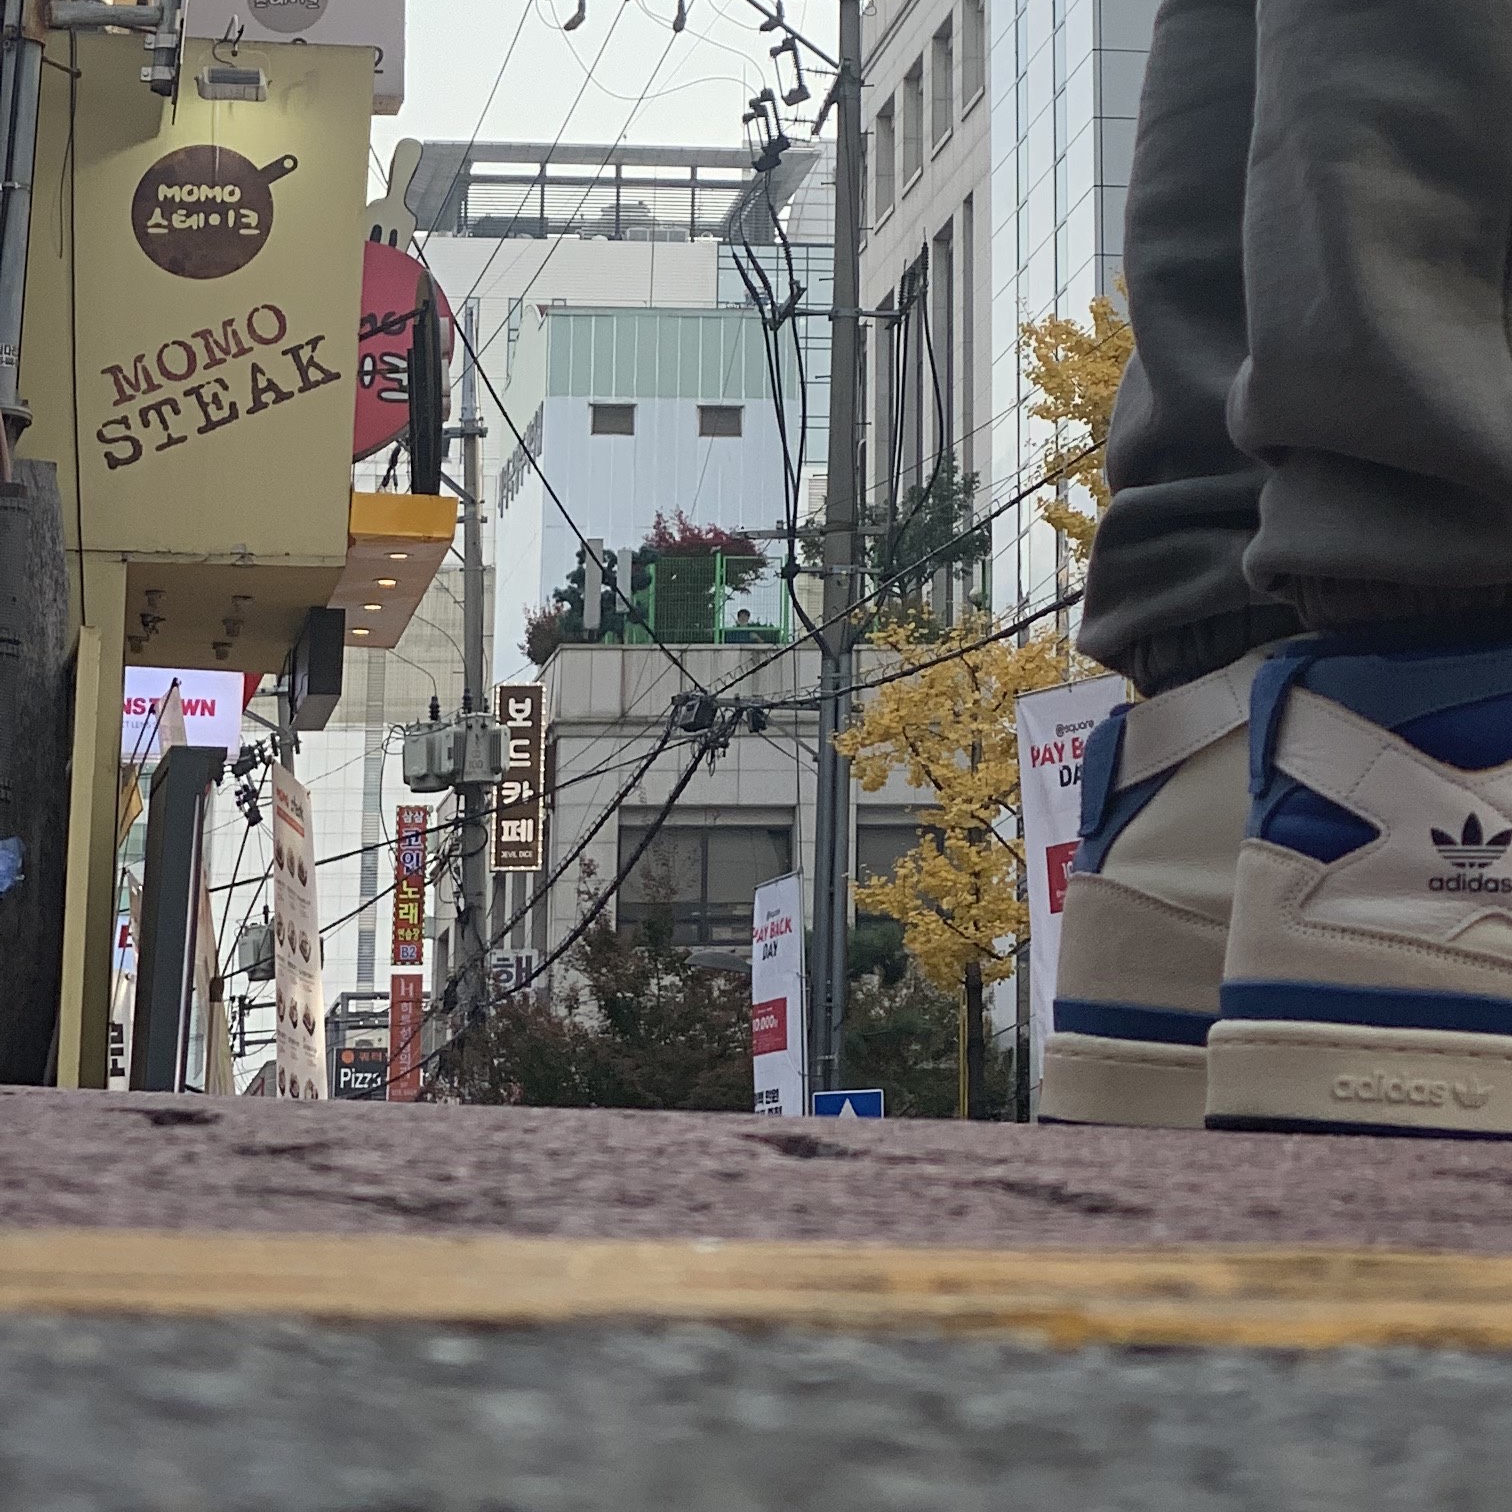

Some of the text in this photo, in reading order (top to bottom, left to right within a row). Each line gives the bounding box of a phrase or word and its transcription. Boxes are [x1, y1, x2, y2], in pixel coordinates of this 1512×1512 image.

[157, 183, 242, 205] MOMO
[146, 210, 261, 236] 스테이크
[100, 303, 288, 407] MOMO
[96, 335, 342, 470] STEAK
[1030, 738, 1066, 768] PAY
[501, 697, 535, 843] 보드카페
[1428, 871, 1512, 895] adidas
[398, 879, 421, 925] 노래
[400, 944, 418, 959] B2
[1333, 1070, 1449, 1107] adidas
